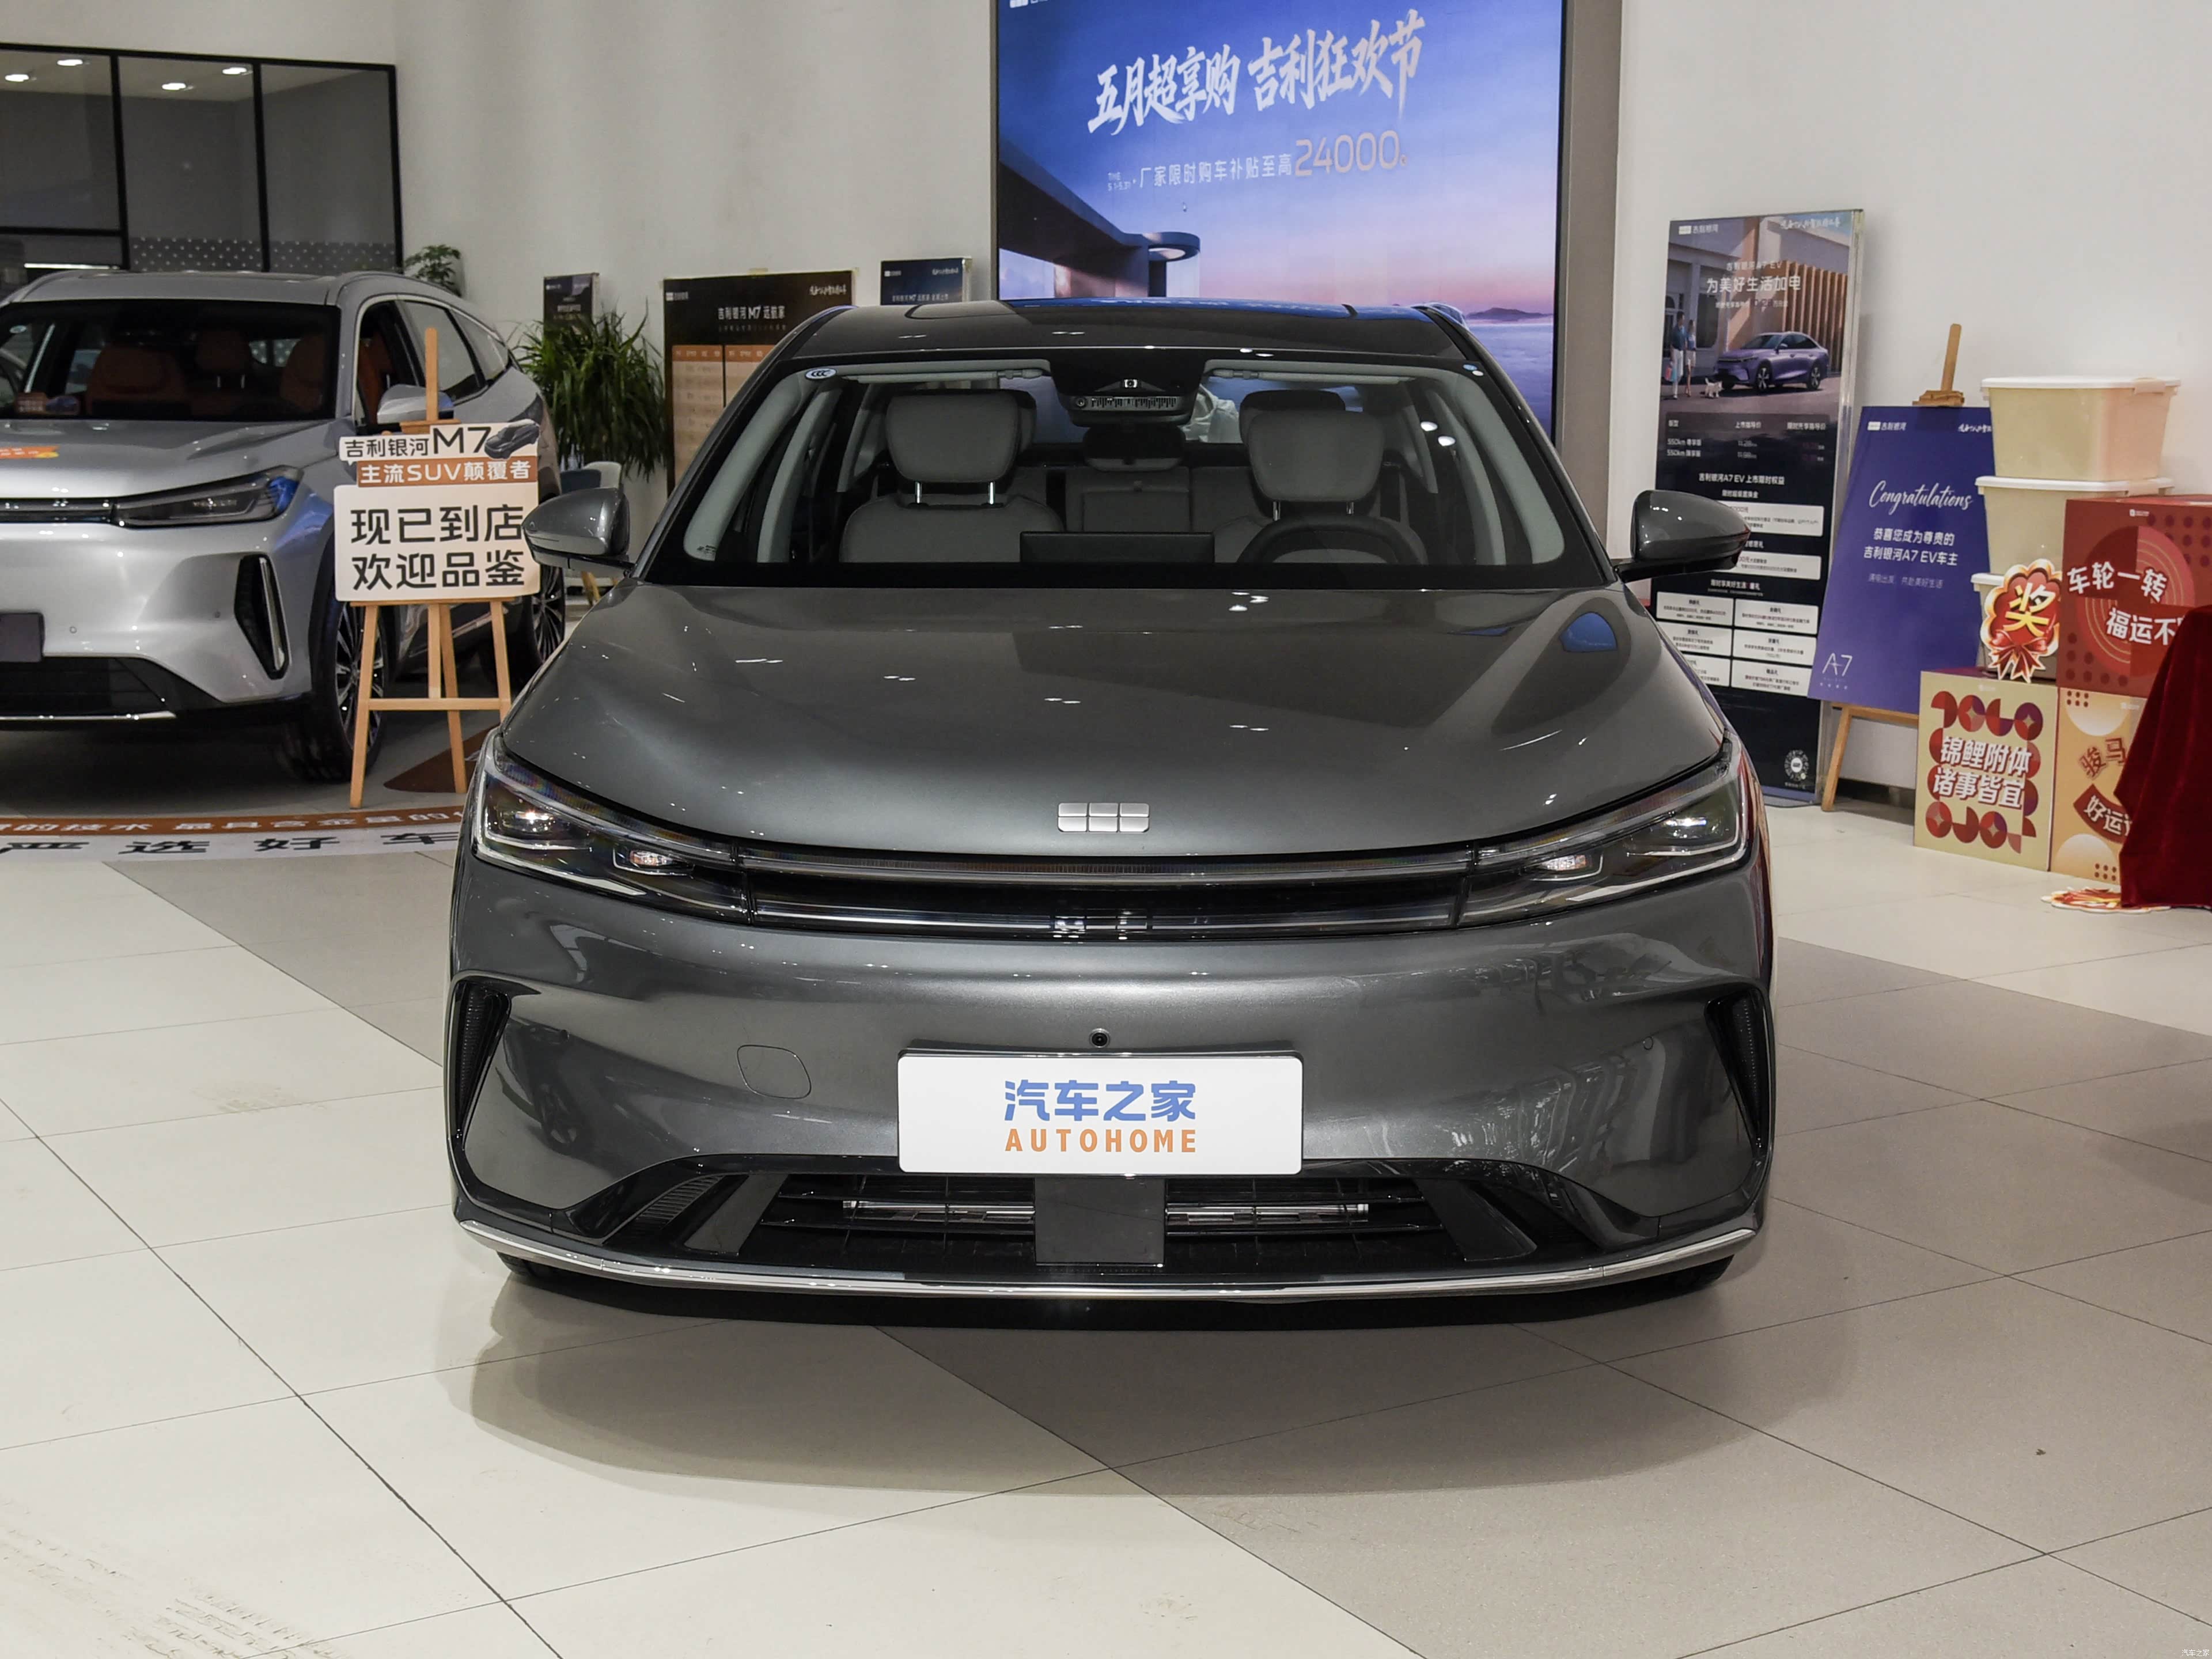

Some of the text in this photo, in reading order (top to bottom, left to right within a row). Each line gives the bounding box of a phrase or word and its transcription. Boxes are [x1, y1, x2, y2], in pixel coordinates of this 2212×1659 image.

[1088, 9, 1425, 135] 五月超享购 吉利狂欢节
[1706, 275, 1801, 294] 为美好生活加电
[361, 460, 531, 484] 主流SUV颠覆者
[1869, 480, 1973, 515] Congratulations
[350, 504, 524, 545] 现已到店
[1873, 528, 1955, 546] 恭喜您成为尊贵的
[351, 550, 525, 590] 欢迎品鉴
[1863, 546, 1958, 566] 吉利银河A7 EV车主
[2067, 562, 2167, 603] 车轮一转
[2002, 582, 2056, 637] 奖
[2106, 608, 2185, 645] 福运不
[1822, 653, 1853, 676] A7
[1941, 736, 2032, 777] 锦鲤附体
[2080, 738, 2126, 778] 骏马
[1933, 767, 2025, 809] 诸事皆宜
[173, 811, 463, 831] 最具含金量的
[0, 832, 459, 855] 严选好车
[1004, 1080, 1196, 1122] 汽车之家
[1005, 1129, 1196, 1153] AUTOHOME
